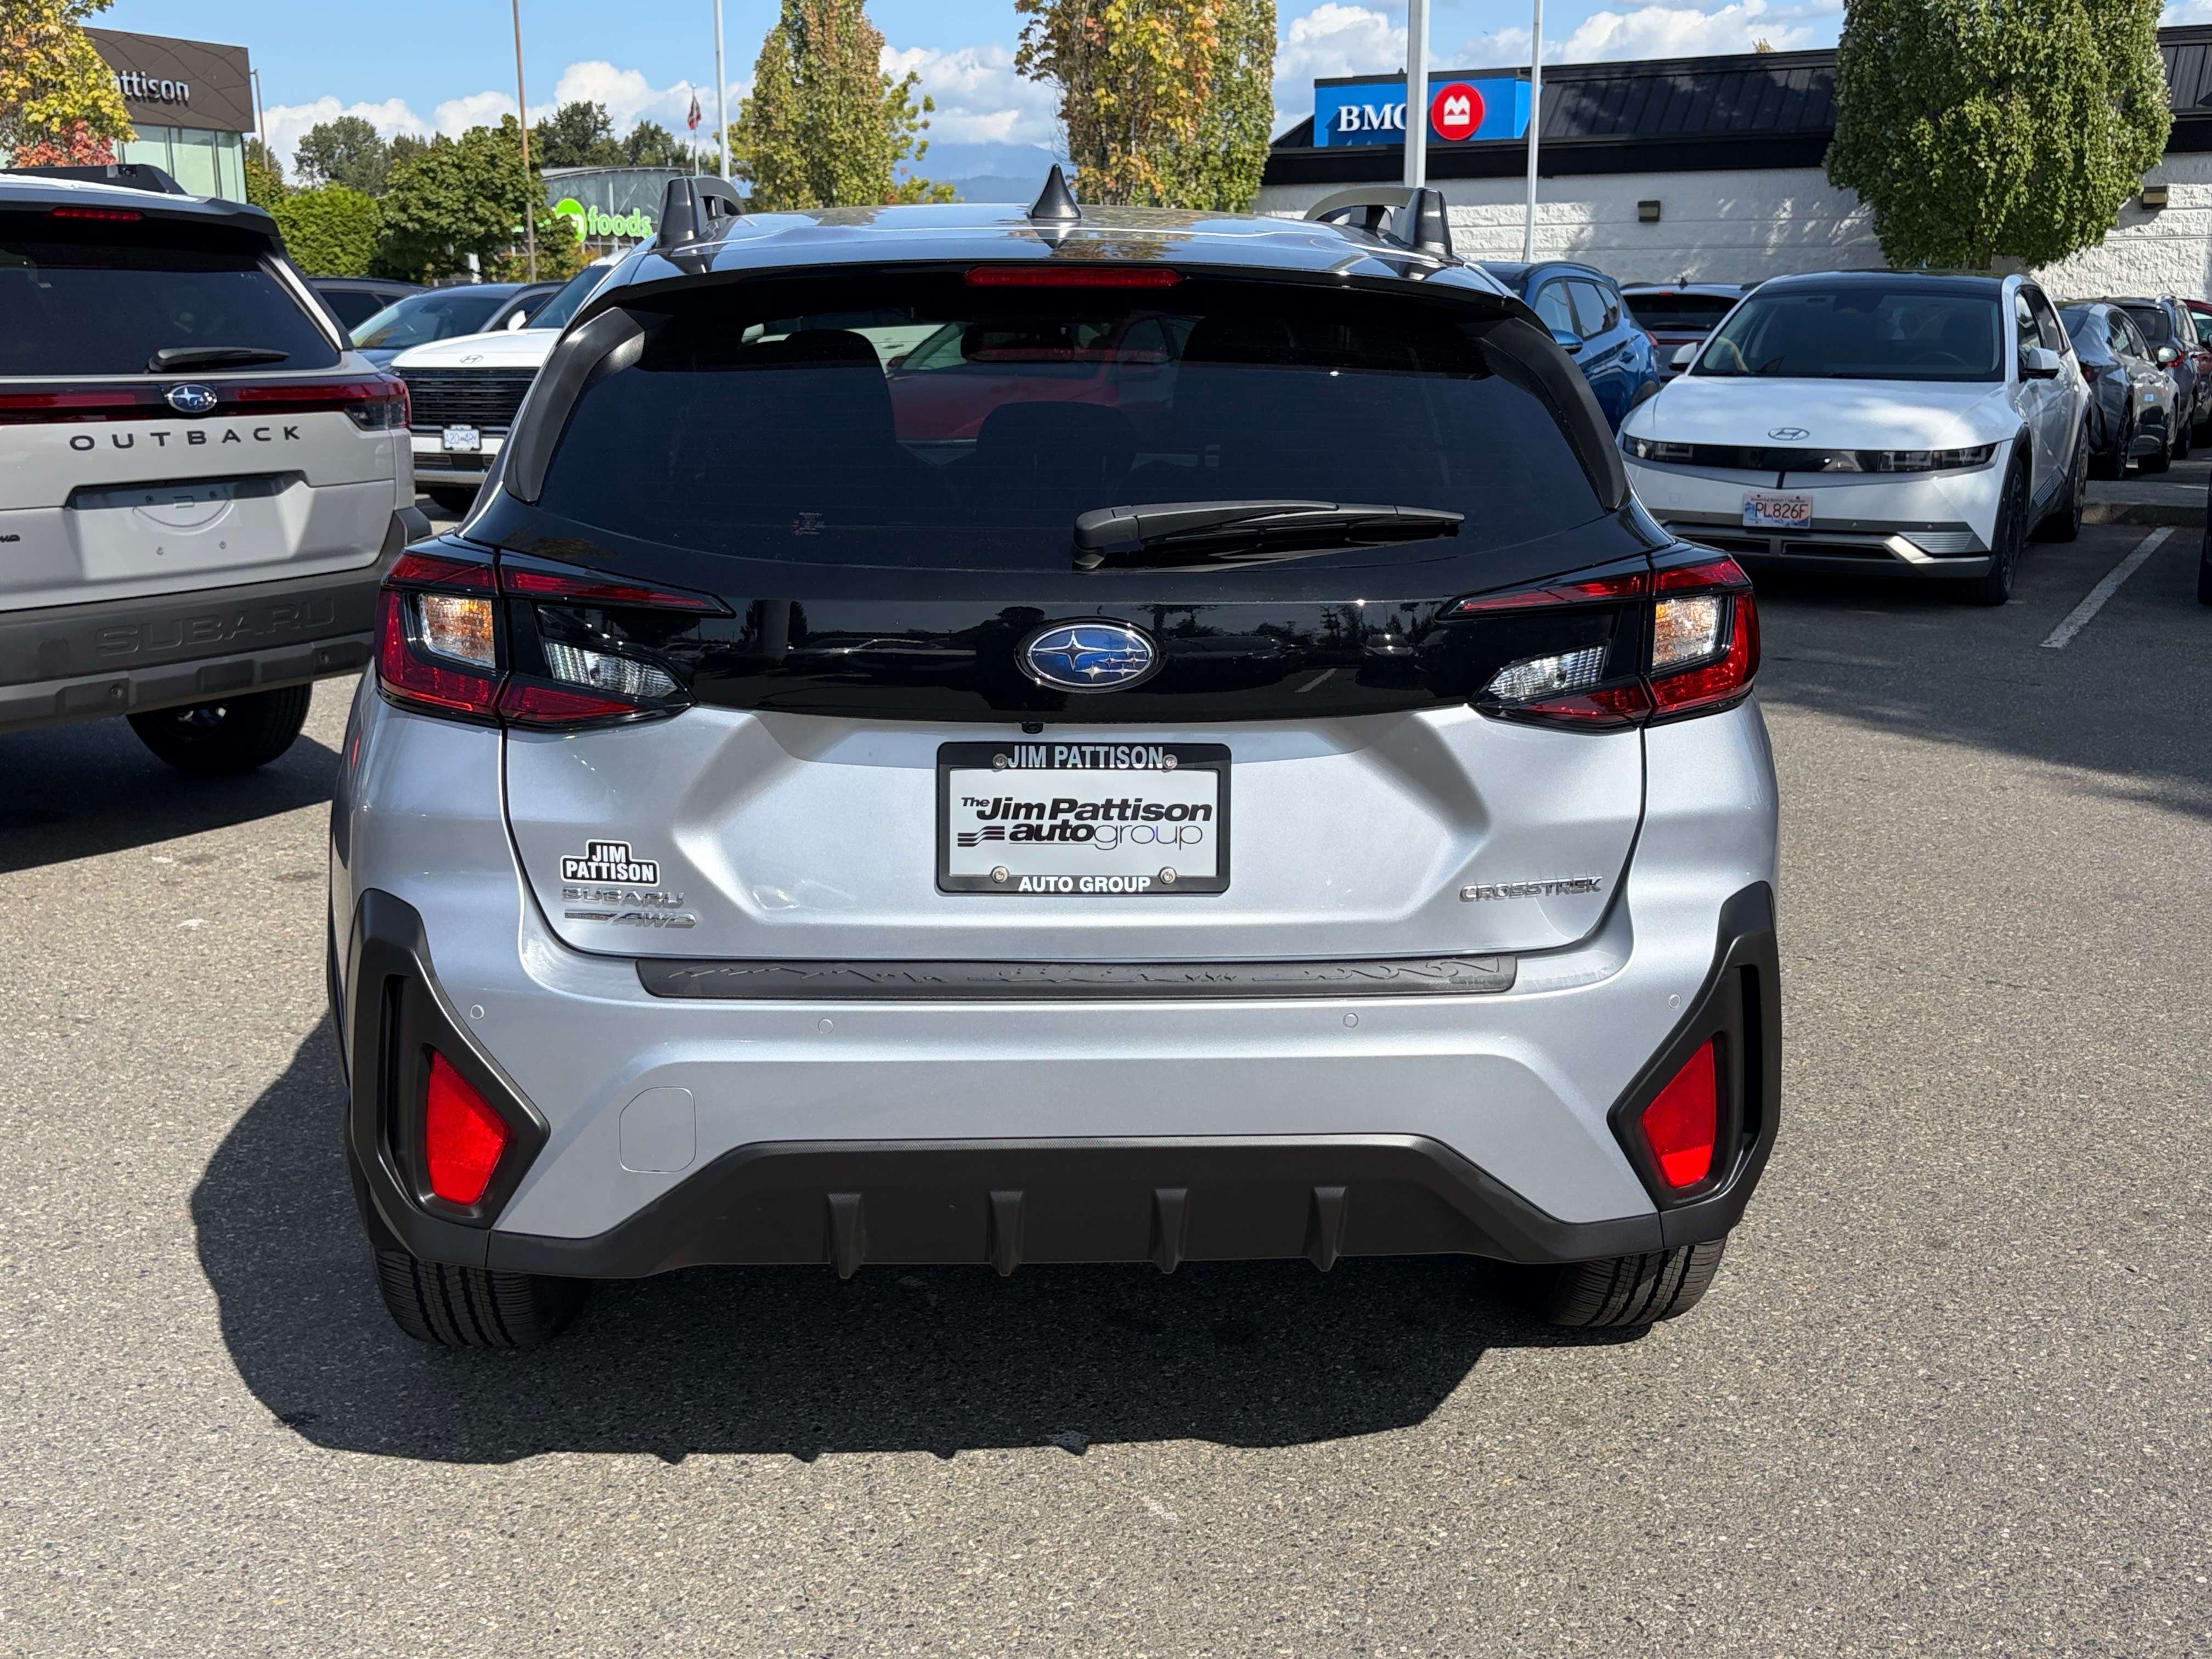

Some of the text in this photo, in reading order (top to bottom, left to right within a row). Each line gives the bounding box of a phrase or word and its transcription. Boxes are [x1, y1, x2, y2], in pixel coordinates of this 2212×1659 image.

[112, 70, 189, 101] attison
[588, 205, 652, 238] foods
[69, 426, 301, 451] OUTBACK
[1755, 502, 1809, 519] PL826F
[0, 535, 21, 543] WD
[95, 599, 335, 657] SUBARU
[1008, 745, 1164, 769] JIM PATTISON
[961, 797, 1212, 821] The Jim Pattison
[592, 845, 626, 863] JIM
[566, 860, 654, 882] PATTISON
[1018, 877, 1151, 893] AUTO GROUP
[1459, 876, 1602, 902] CROSSTREK
[562, 886, 685, 909] SUBARU
[611, 911, 697, 929] AWD
